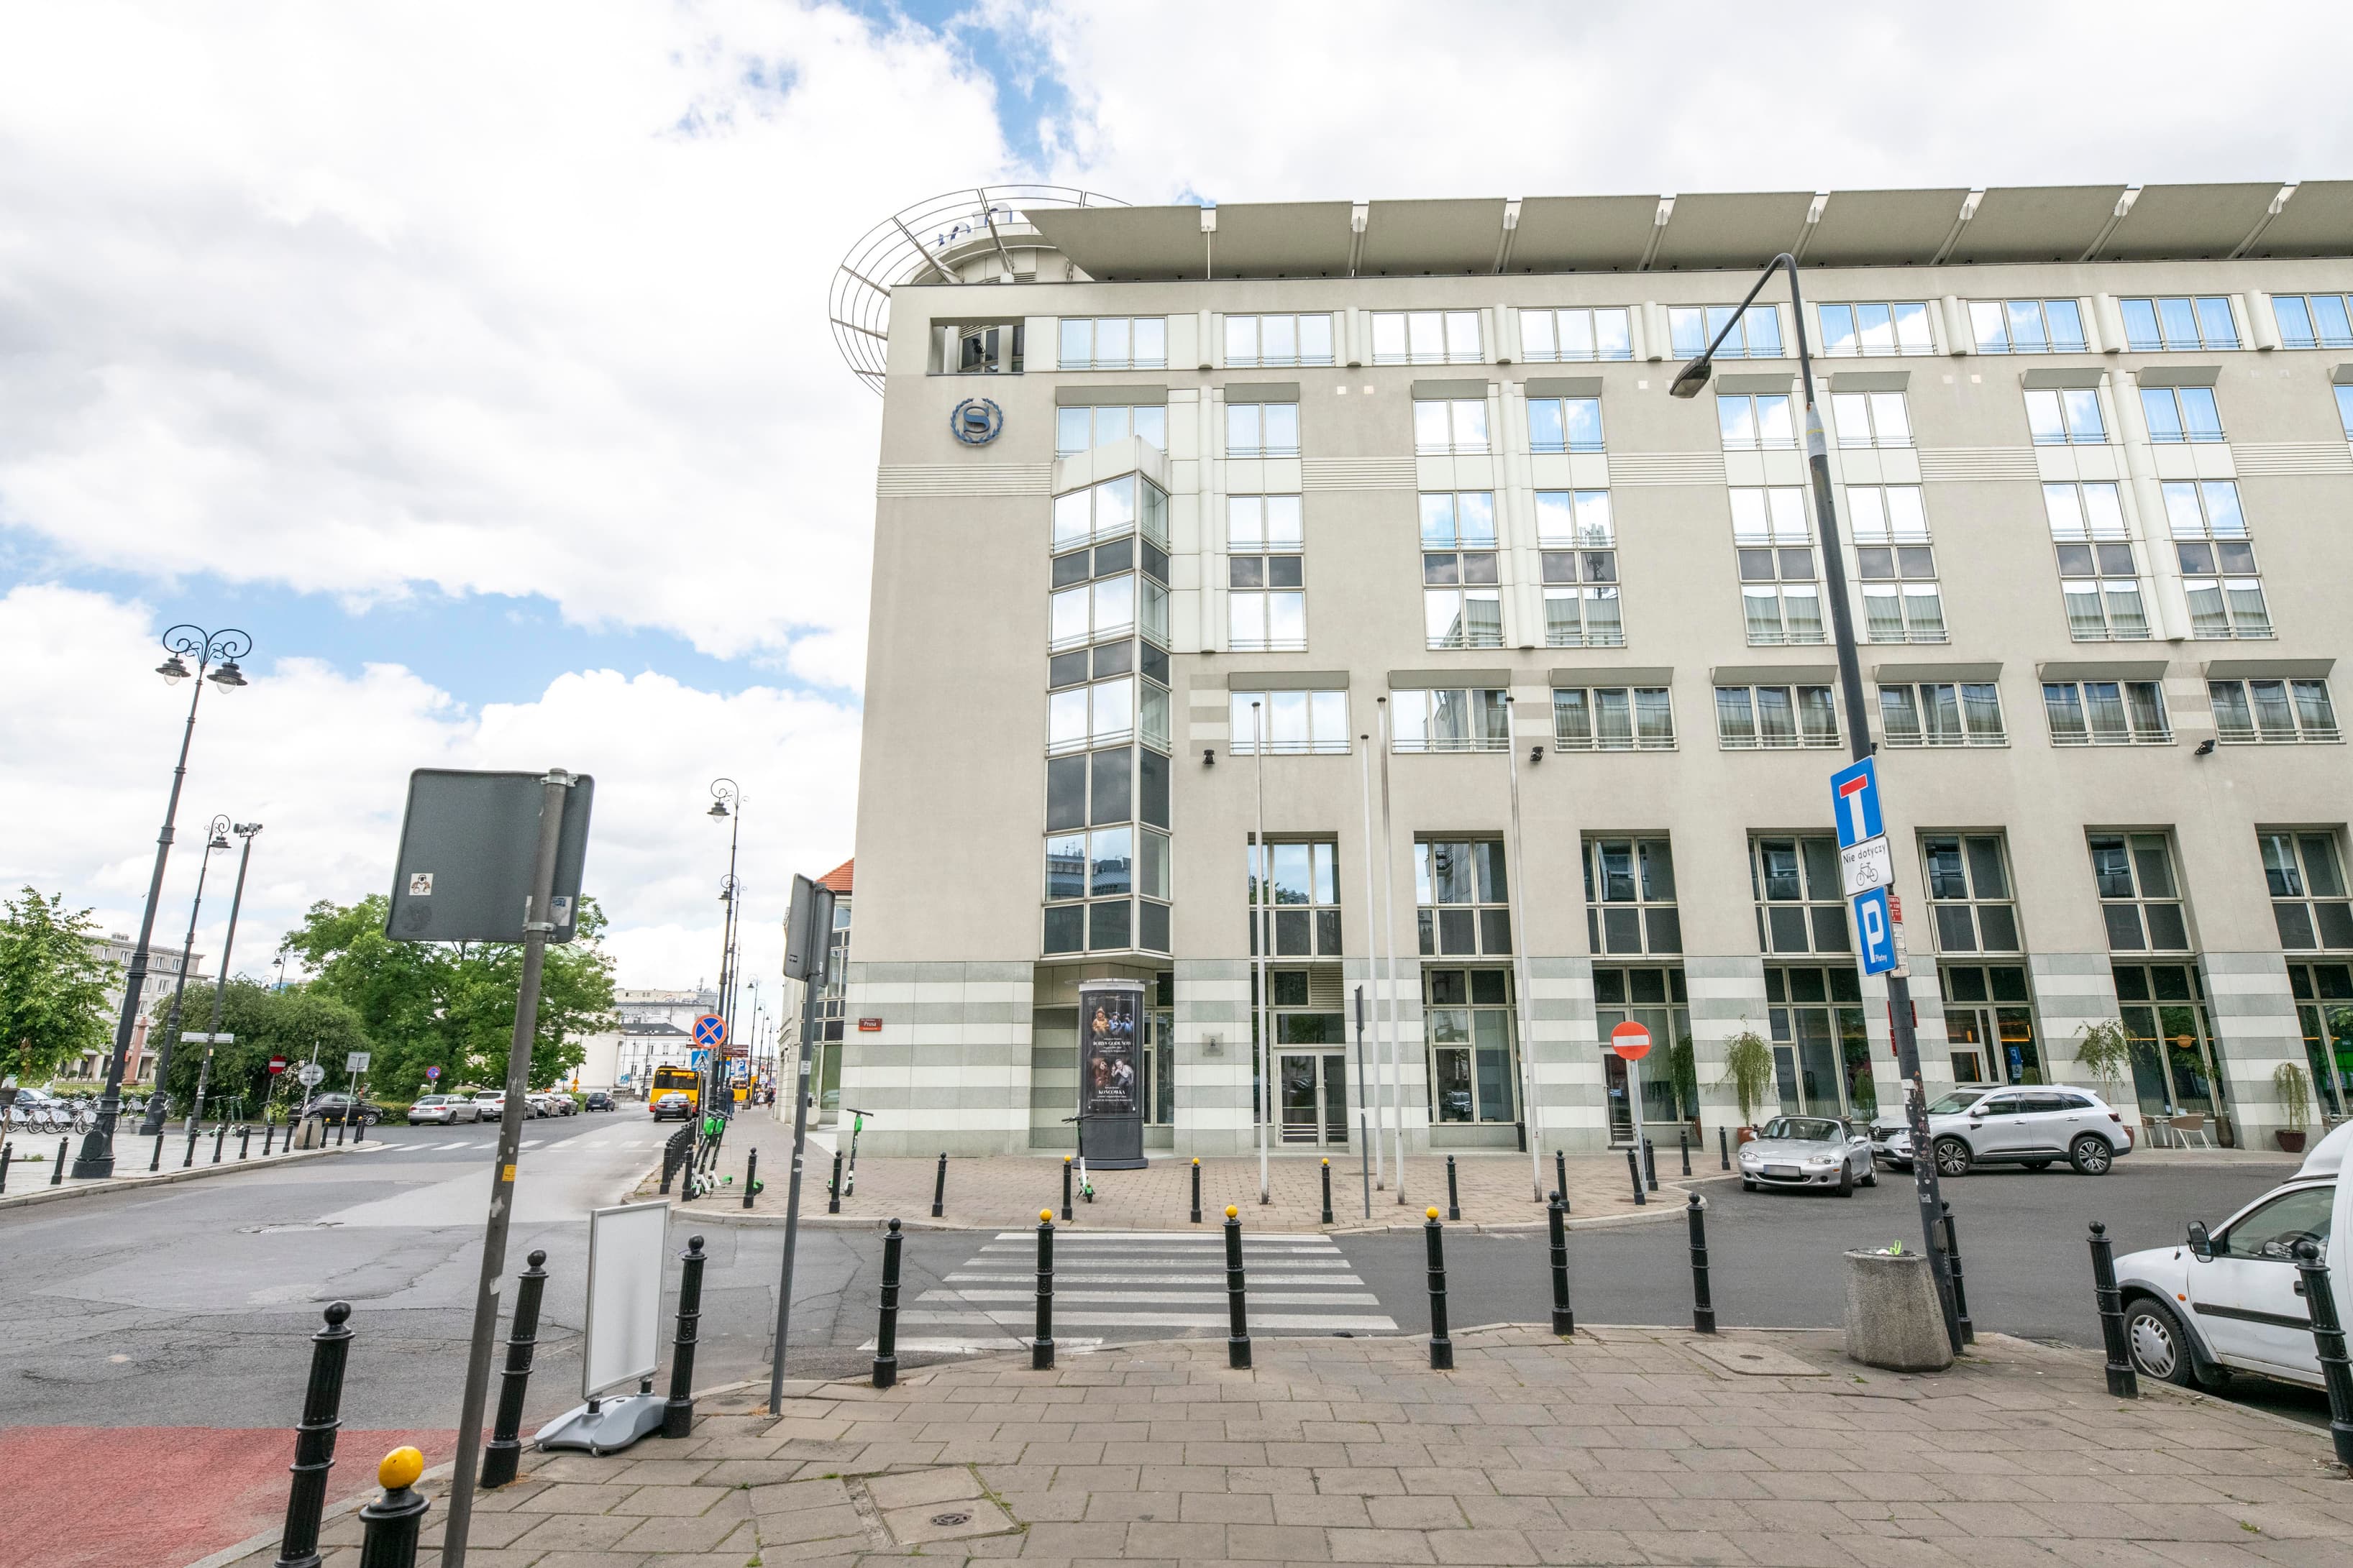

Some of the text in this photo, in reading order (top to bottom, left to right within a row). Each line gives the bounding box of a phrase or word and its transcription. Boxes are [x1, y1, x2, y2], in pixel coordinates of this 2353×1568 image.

[964, 406, 990, 434] S
[1843, 843, 1886, 864] Nie dotyczy
[1862, 899, 1884, 964] P
